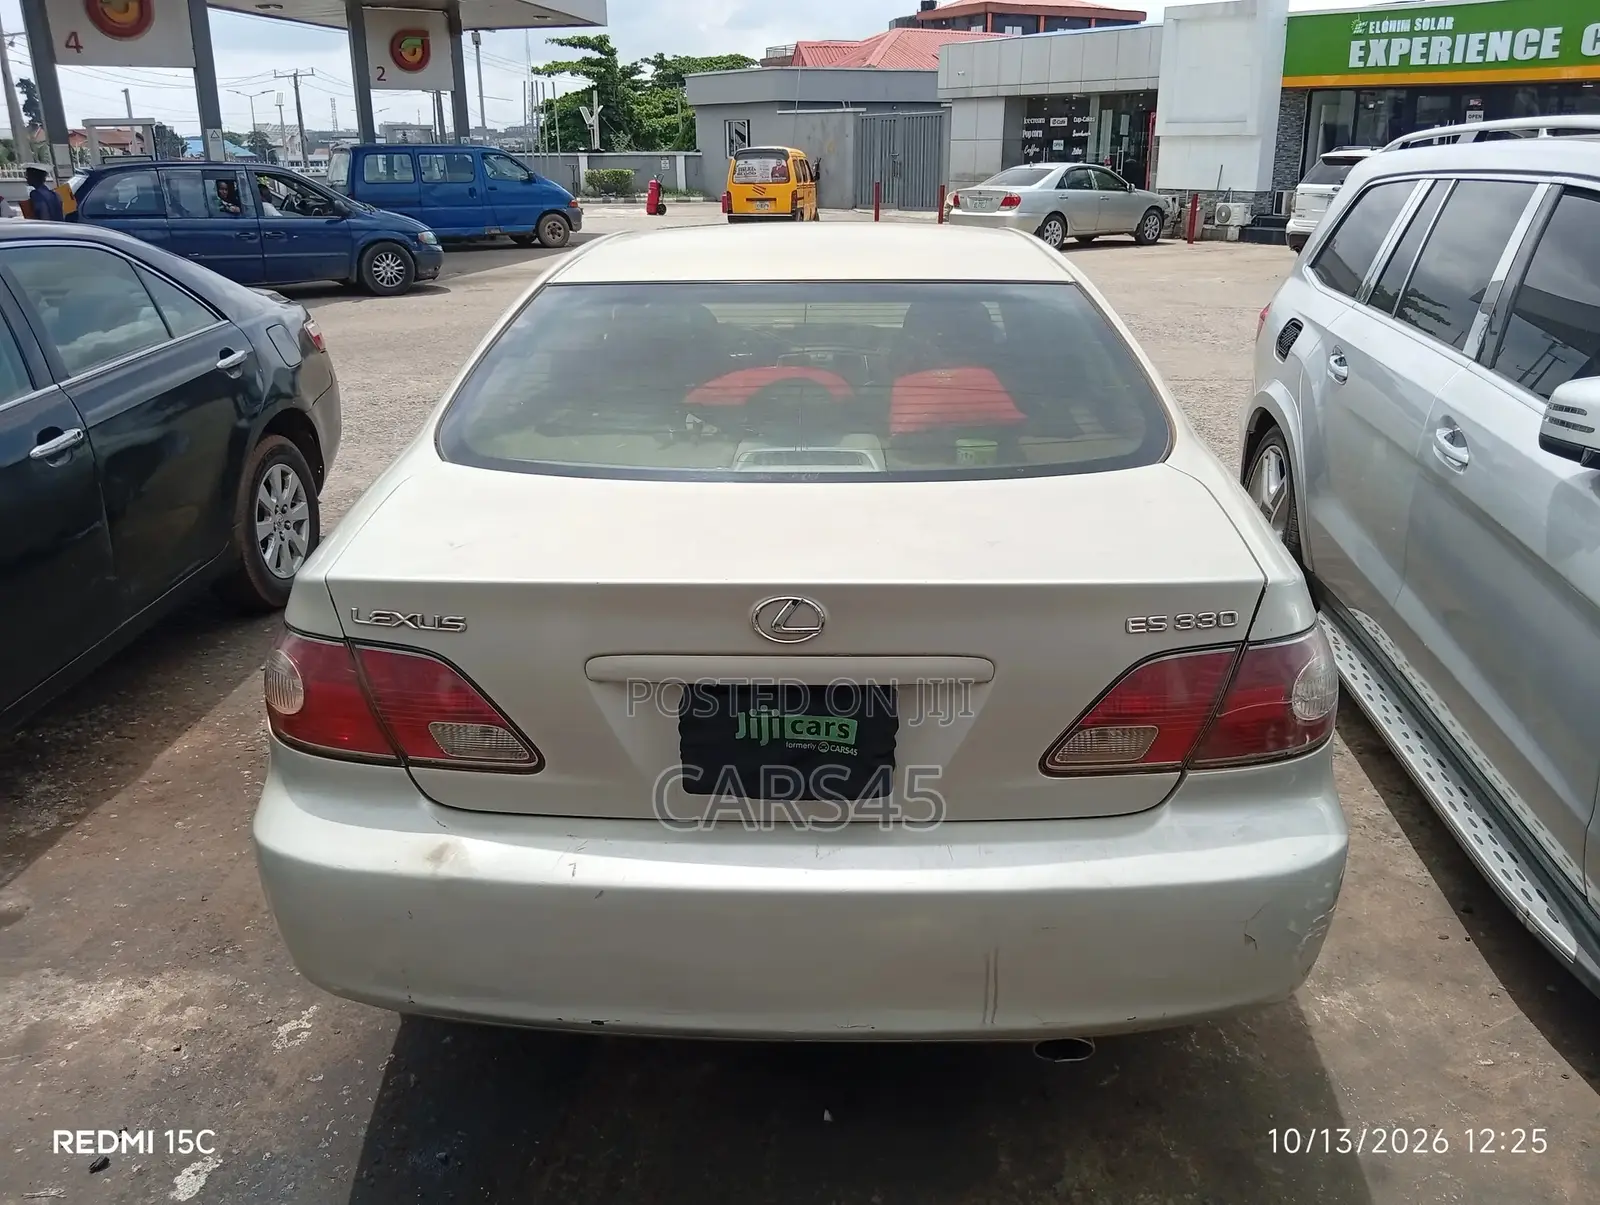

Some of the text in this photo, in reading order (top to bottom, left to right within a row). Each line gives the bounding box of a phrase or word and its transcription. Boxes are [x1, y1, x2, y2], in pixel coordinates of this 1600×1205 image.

[1414, 16, 1454, 31] SOLAR
[65, 31, 84, 54] 4
[1348, 26, 1563, 68] EXPERIENCE
[376, 66, 387, 81] 2
[1024, 144, 1040, 156] Coffee
[350, 607, 467, 633] LEXUS
[1125, 610, 1239, 634] ES 330
[790, 718, 850, 739] cars
[785, 741, 858, 756] formerly CARS45
